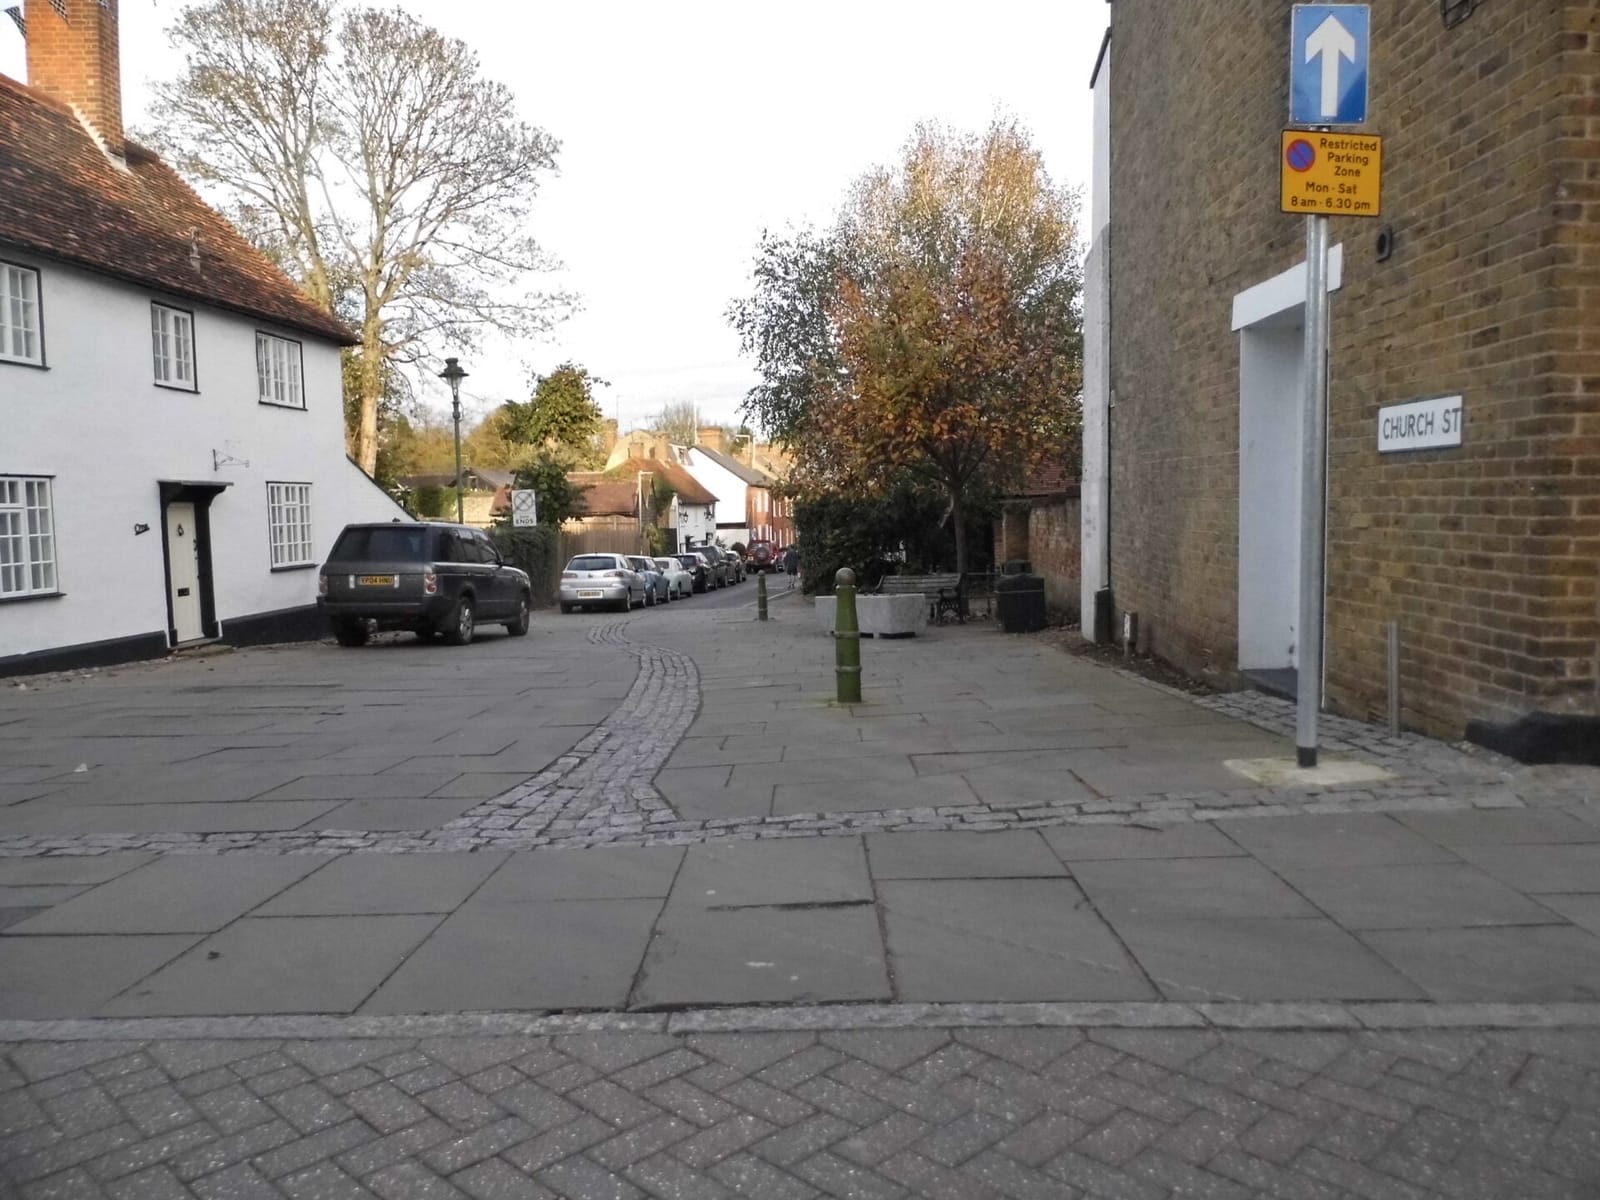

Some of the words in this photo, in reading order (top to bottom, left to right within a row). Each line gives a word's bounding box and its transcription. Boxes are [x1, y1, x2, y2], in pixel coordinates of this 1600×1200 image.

[1320, 138, 1377, 151] Restricted
[1327, 152, 1369, 166] Parking
[1334, 166, 1361, 177] Zone
[1305, 182, 1329, 193] Mon
[1337, 183, 1357, 194] Sat
[1325, 197, 1352, 208] 6.30
[1354, 201, 1370, 210] pm
[1382, 410, 1435, 440] CHURCH
[1442, 407, 1461, 434] ST
